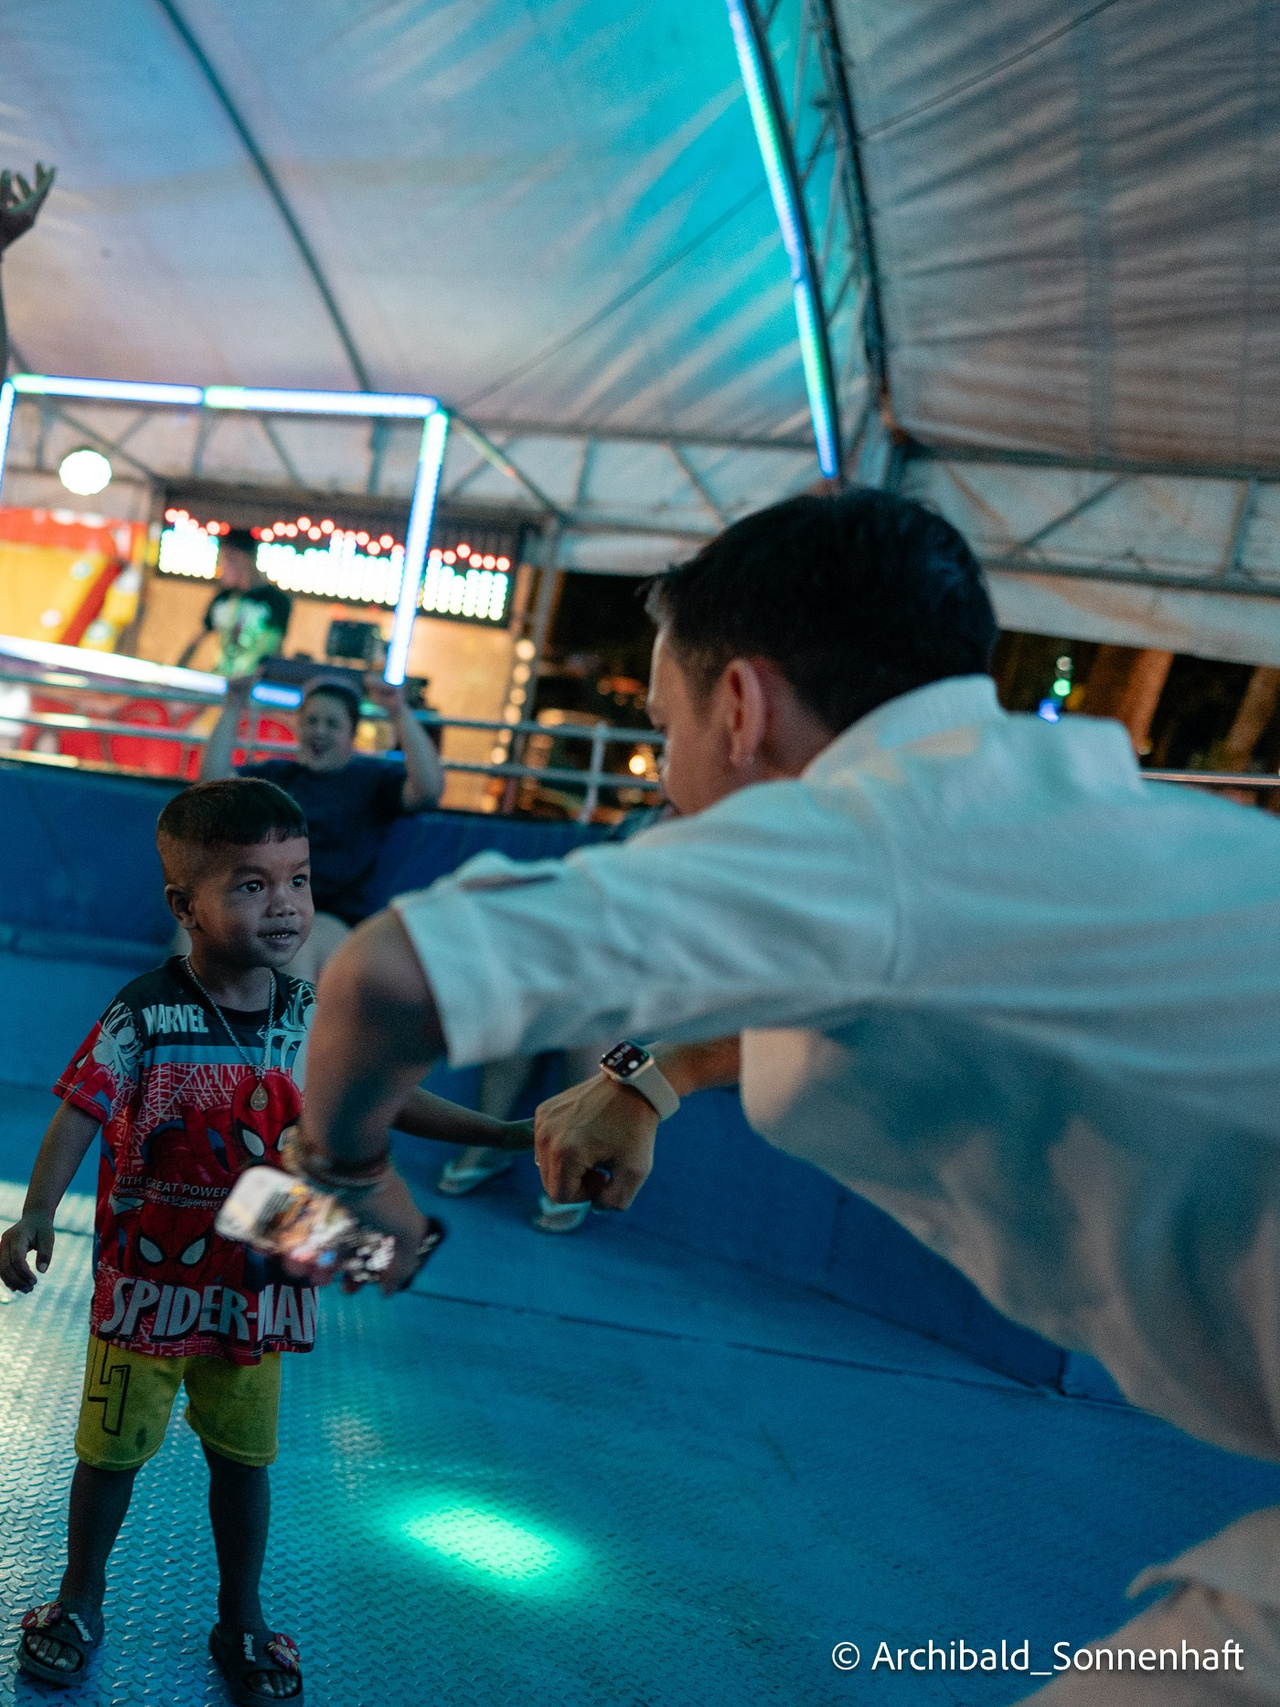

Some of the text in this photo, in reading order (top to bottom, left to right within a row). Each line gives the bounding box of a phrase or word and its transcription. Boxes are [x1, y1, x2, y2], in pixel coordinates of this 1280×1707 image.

[142, 1004, 209, 1036] MARVEL
[145, 1177, 180, 1193] GREAT
[182, 1184, 229, 1198] POWER
